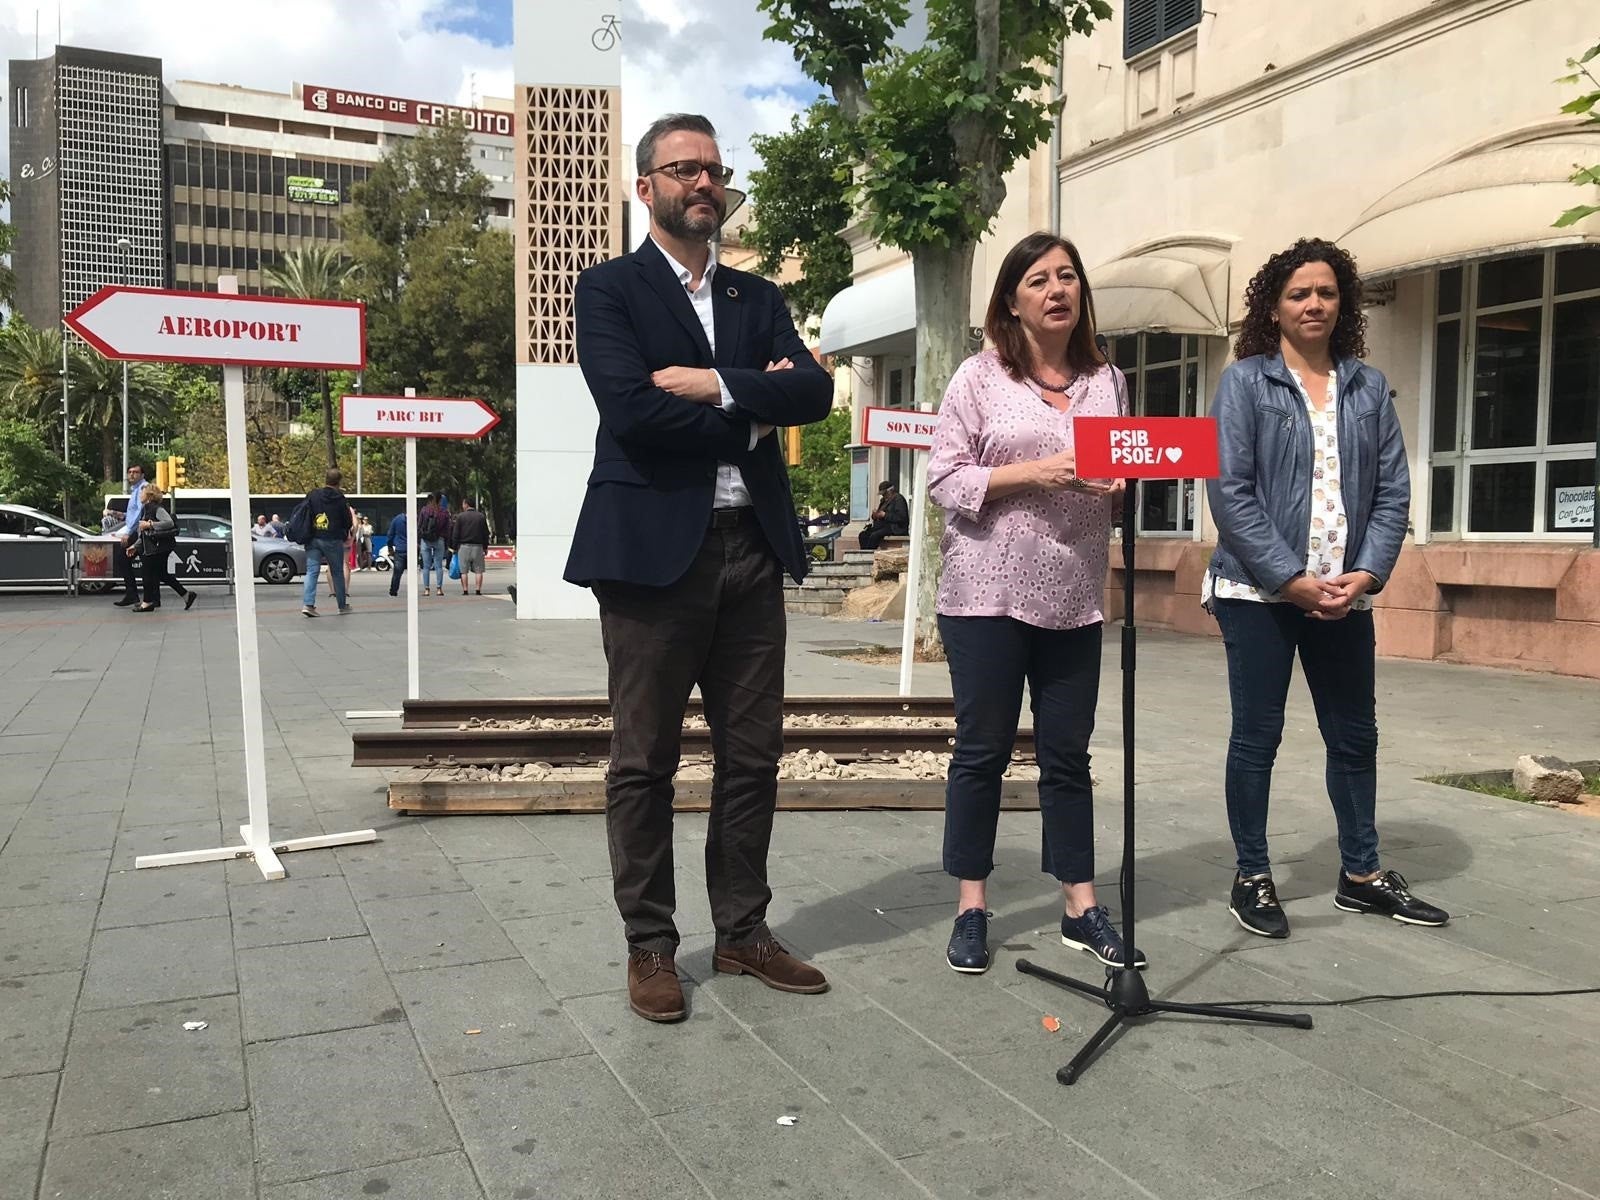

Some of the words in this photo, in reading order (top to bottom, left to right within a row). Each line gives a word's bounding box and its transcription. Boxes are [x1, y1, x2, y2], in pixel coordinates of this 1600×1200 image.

[336, 93, 384, 109] BANCO
[389, 101, 407, 112] DE
[416, 104, 509, 134] CREDITO
[158, 316, 301, 342] AEROPORT
[377, 410, 415, 421] PARC
[420, 411, 444, 422] BIT
[887, 421, 911, 433] SON
[1110, 430, 1148, 446] PSIB
[1559, 490, 1595, 503] Chocolate
[1559, 511, 1573, 520] Con
